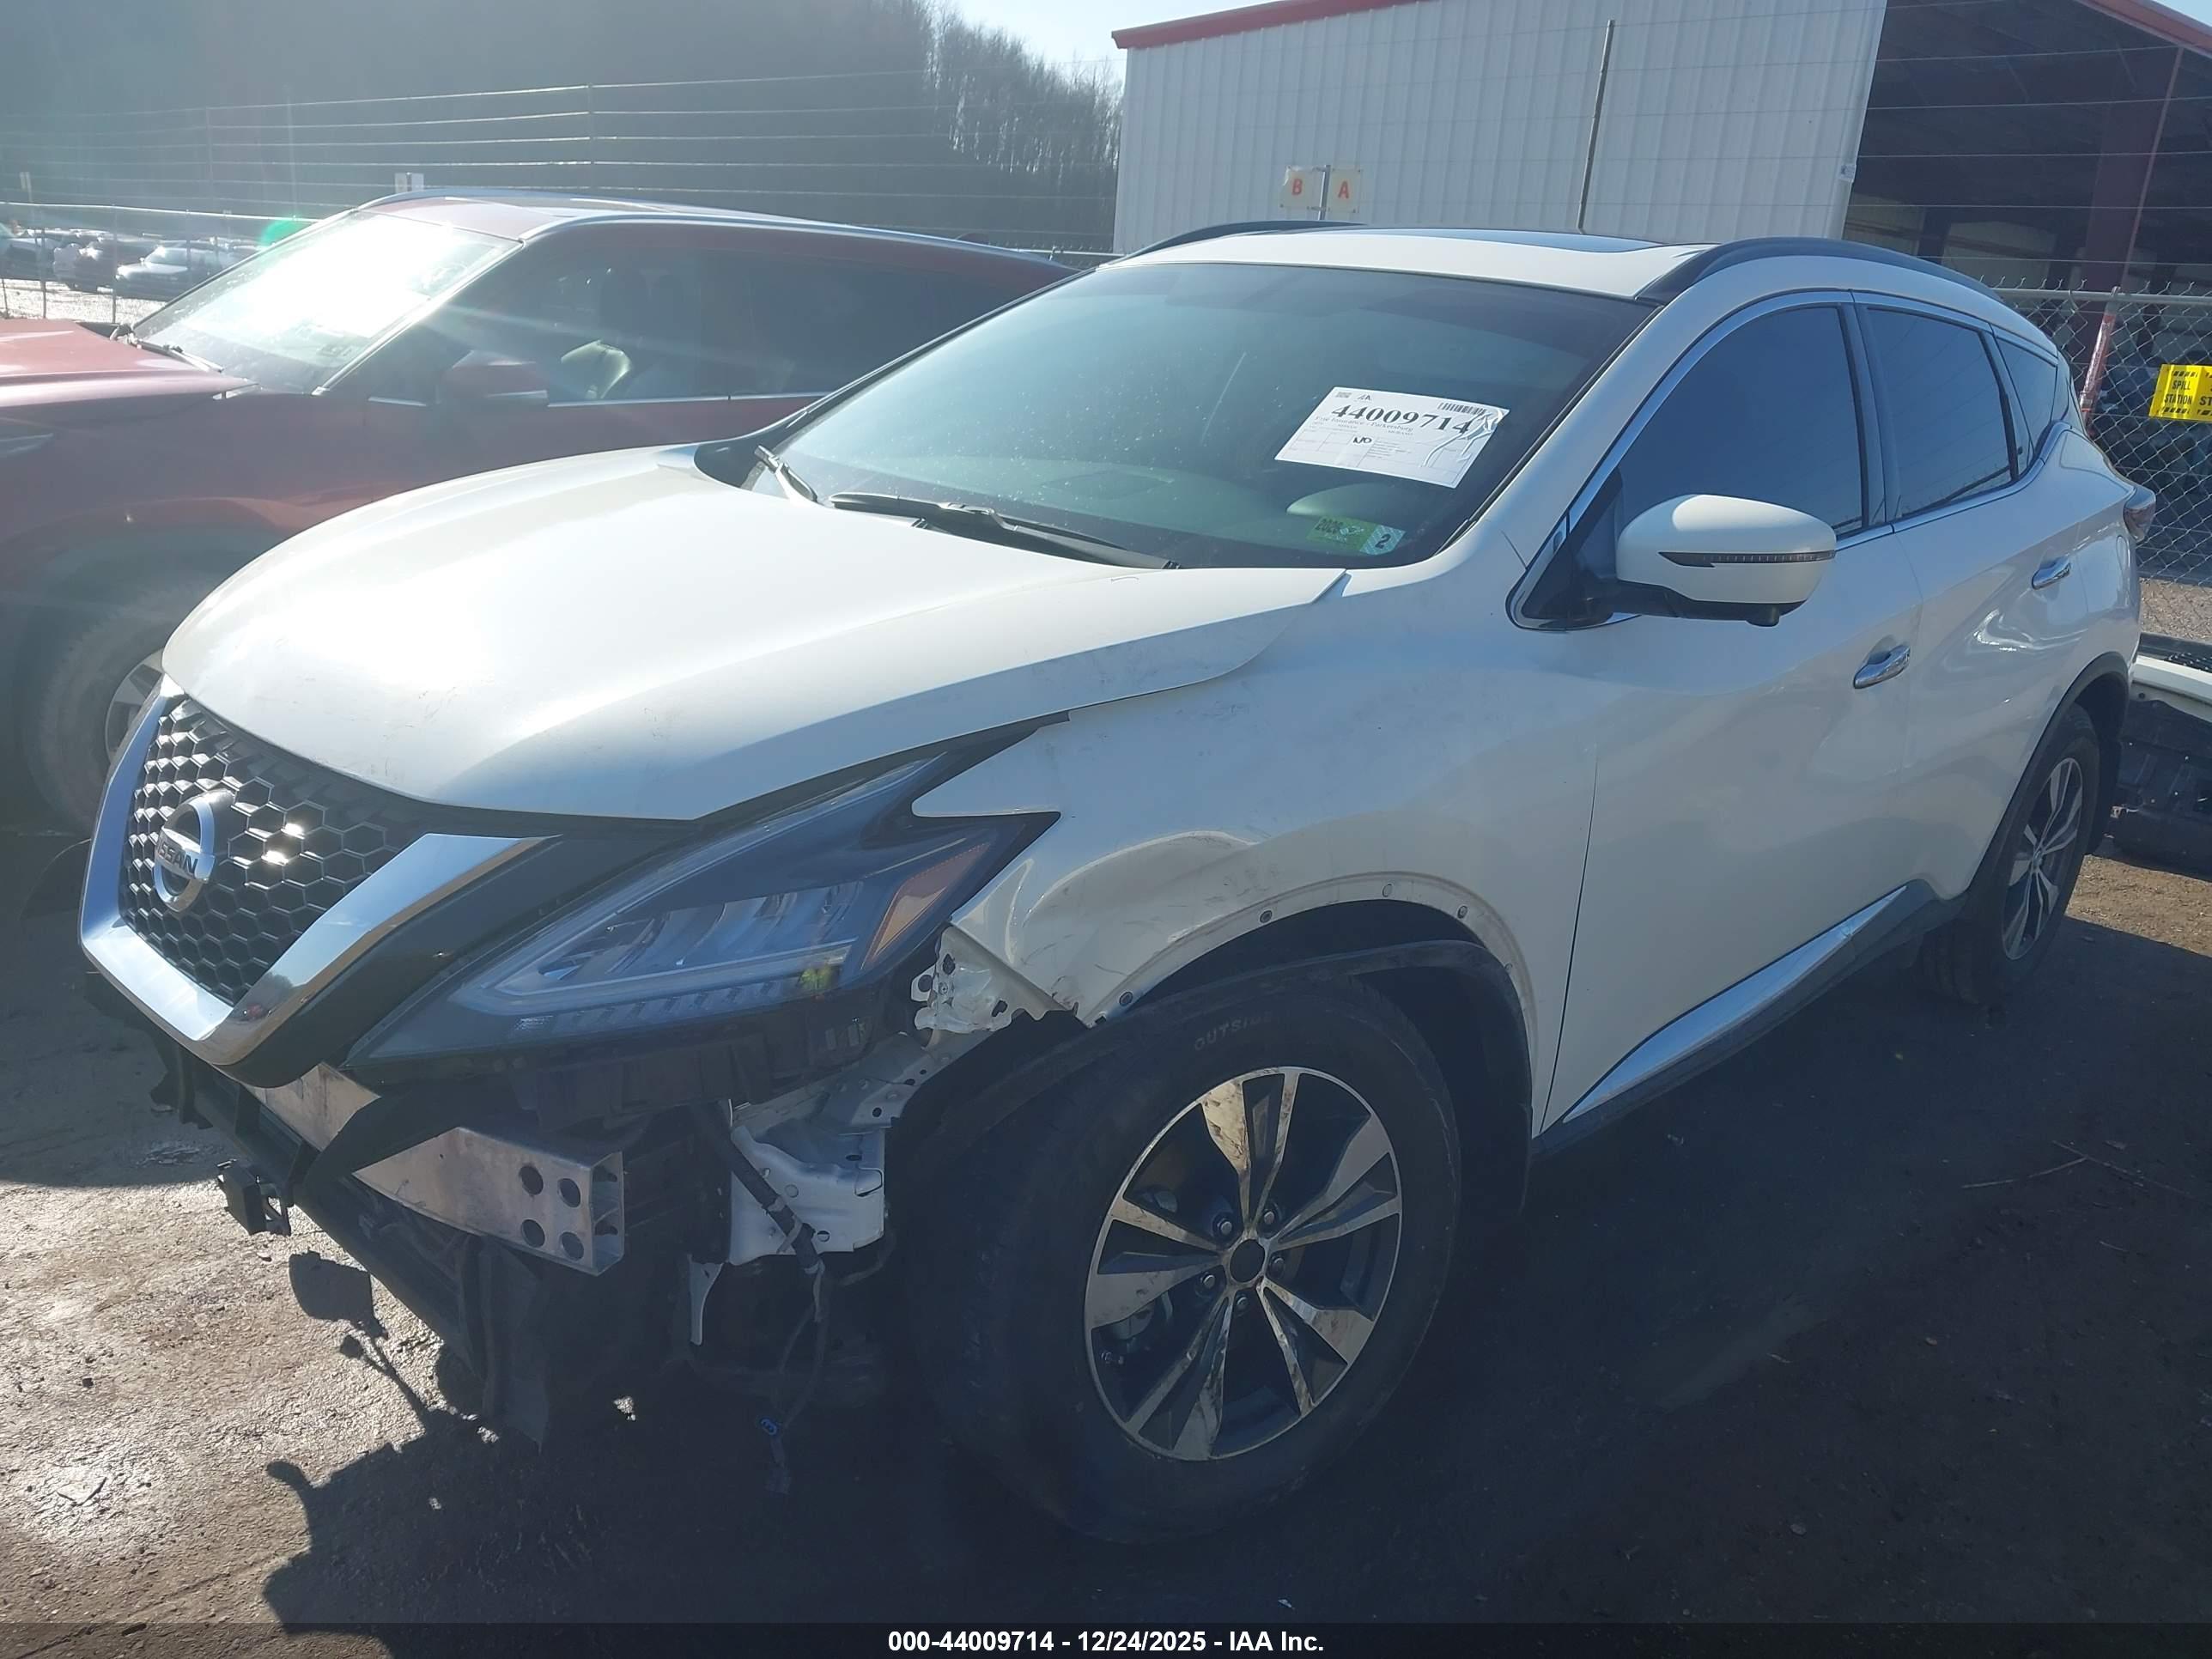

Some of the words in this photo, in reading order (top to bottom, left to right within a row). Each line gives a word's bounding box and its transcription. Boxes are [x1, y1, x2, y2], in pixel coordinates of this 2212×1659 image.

[1291, 178, 1304, 196] B
[1338, 180, 1350, 198] A
[2172, 380, 2191, 390] SPILL
[2165, 393, 2193, 404] STATION
[1331, 404, 1472, 434] 44009714
[1375, 533, 1391, 550] 2
[1194, 1011, 1270, 1051] OUTSID
